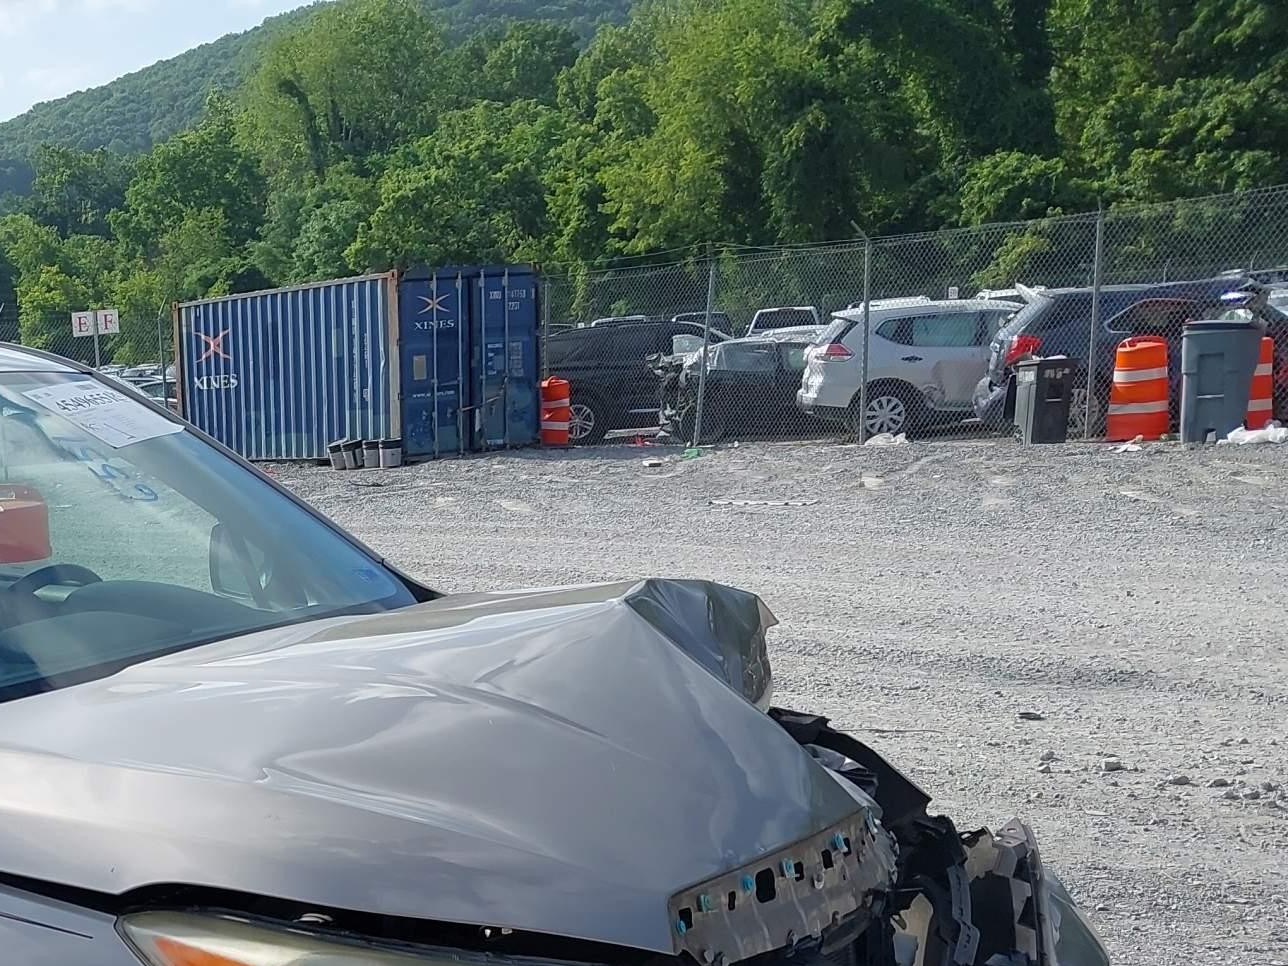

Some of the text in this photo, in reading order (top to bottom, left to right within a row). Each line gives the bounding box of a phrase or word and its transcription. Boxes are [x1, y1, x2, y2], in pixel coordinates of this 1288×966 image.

[77, 316, 89, 332] E
[103, 314, 113, 330] F
[194, 374, 238, 390] XINES
